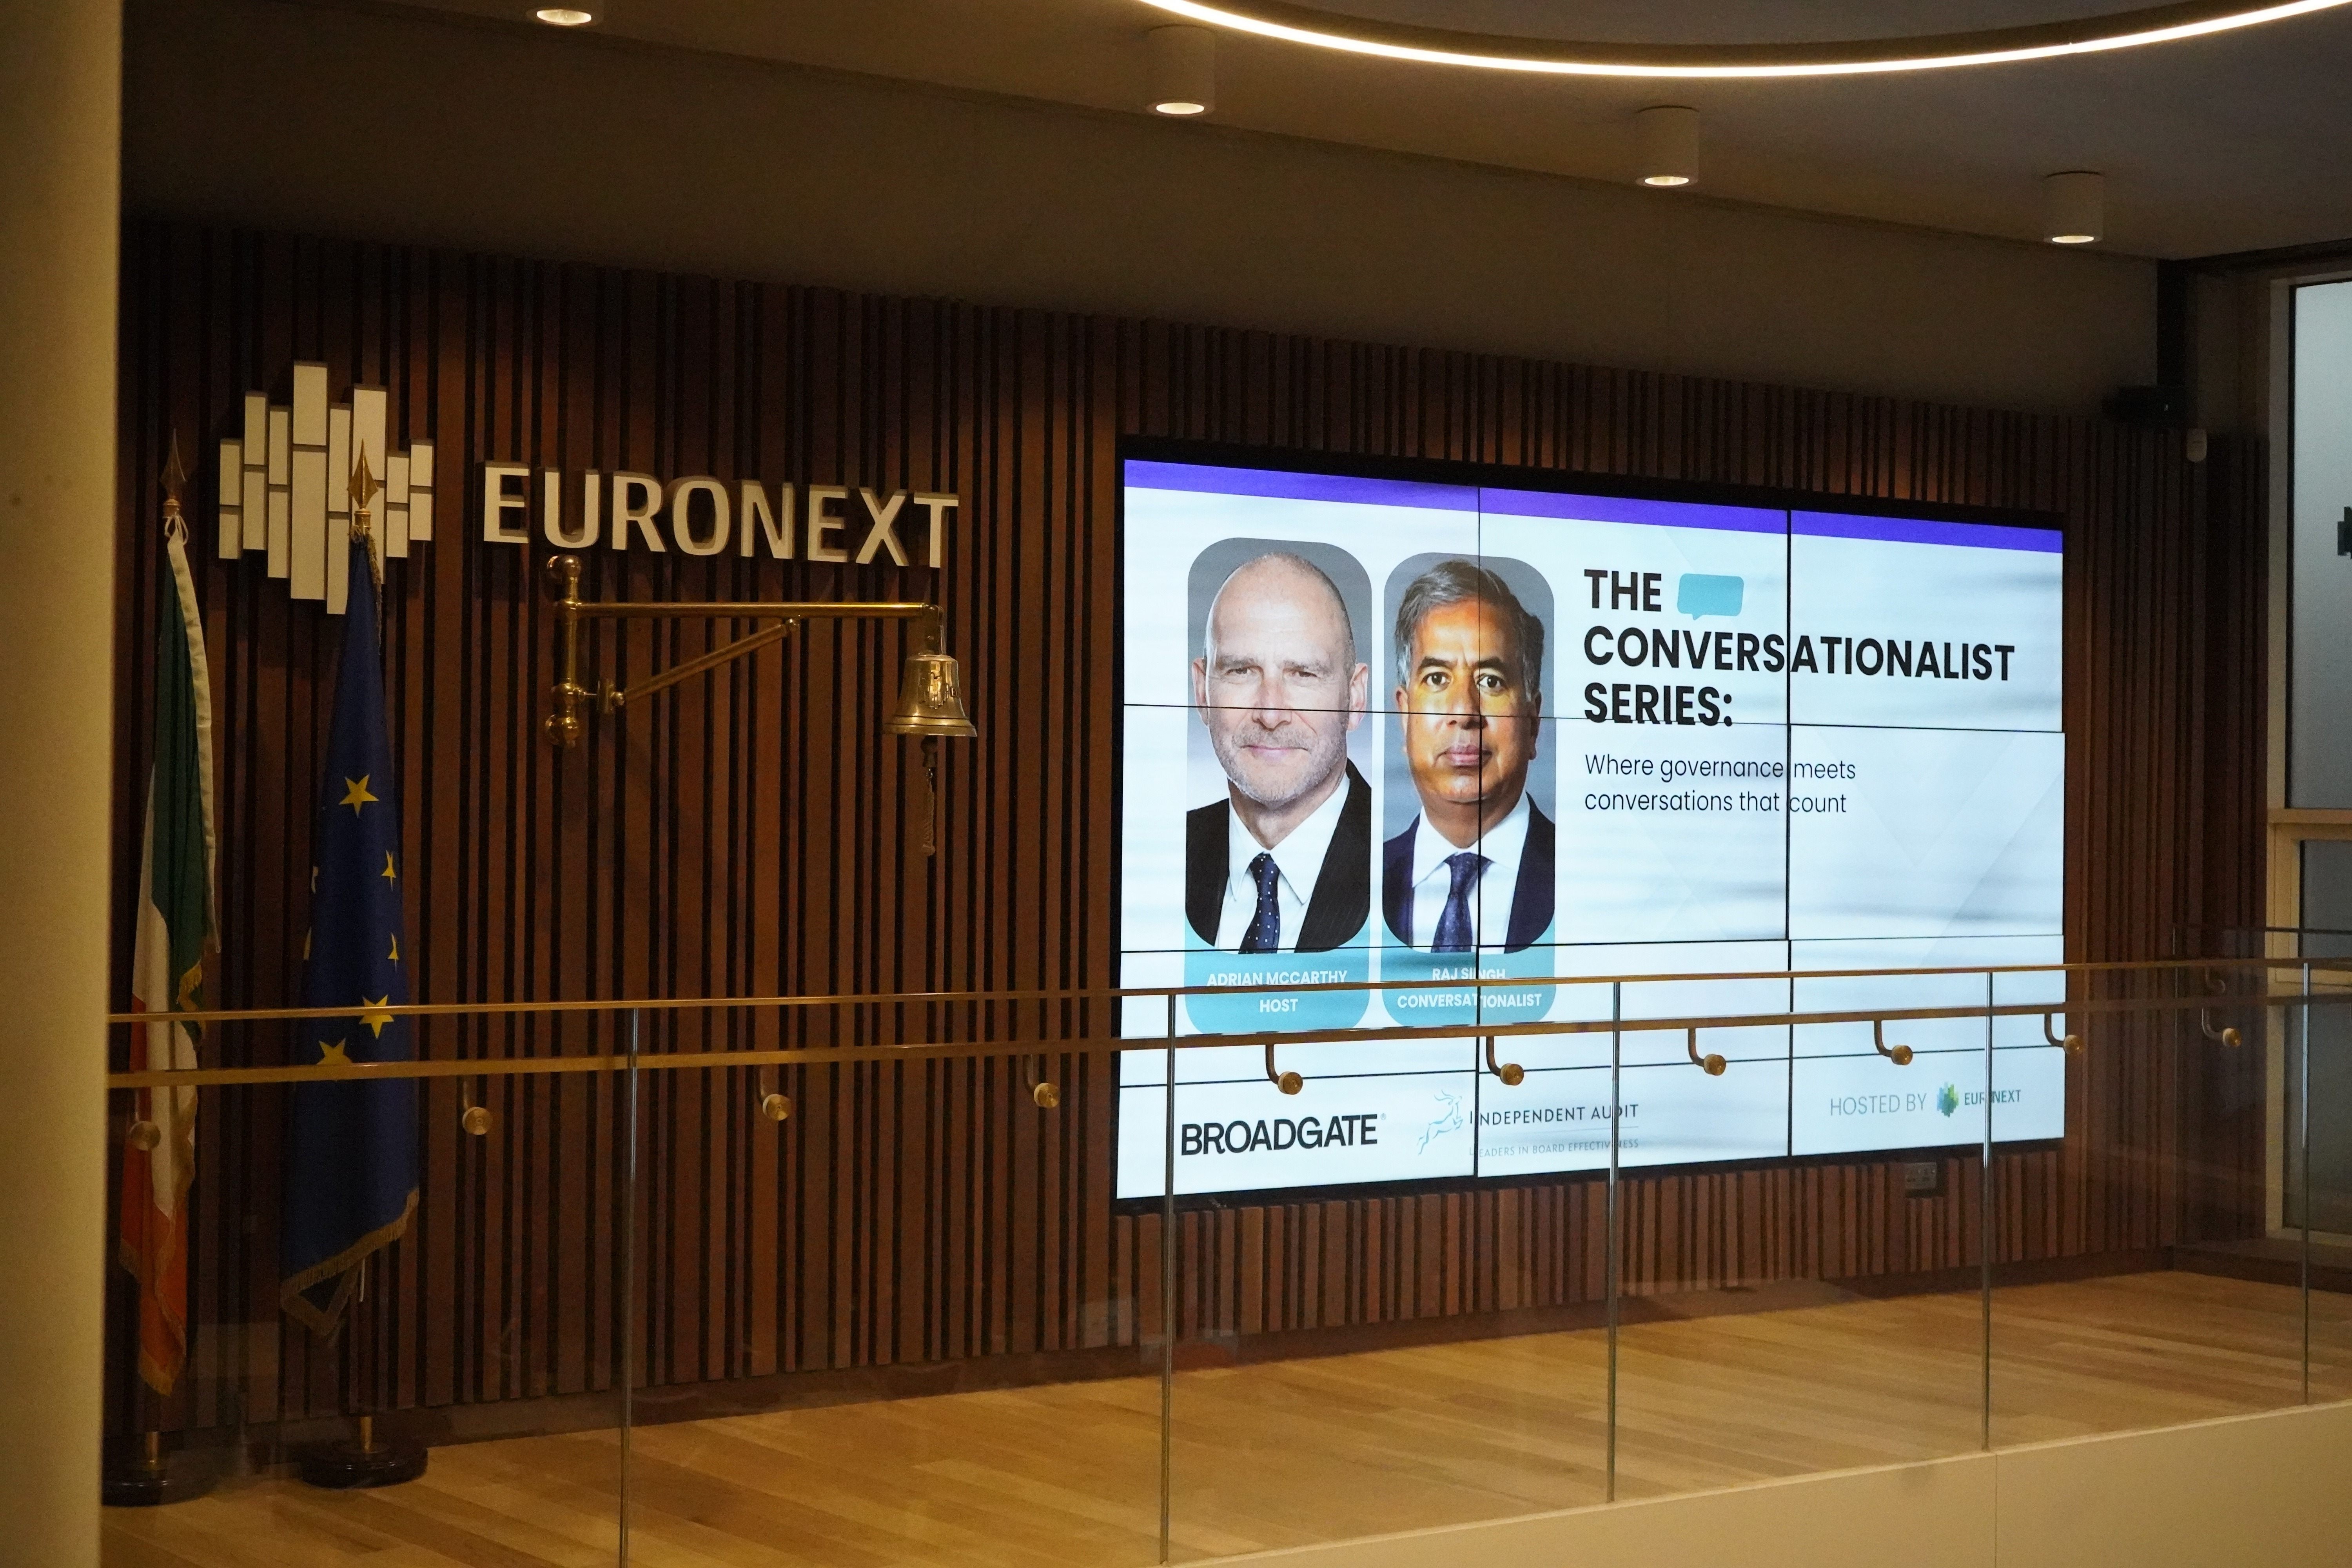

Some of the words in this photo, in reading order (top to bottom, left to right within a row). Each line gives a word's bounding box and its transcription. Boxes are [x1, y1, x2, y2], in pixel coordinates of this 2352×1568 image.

[483, 461, 960, 568] EURONEXT
[1584, 569, 1662, 612] THE
[1584, 626, 2015, 681] CONVERSATIONALIST
[1584, 682, 1733, 727] SERIES:
[1585, 754, 1653, 776] Where
[1661, 759, 1784, 782] governance
[1794, 760, 1856, 779] meets
[1585, 790, 1733, 811] conversations
[1739, 791, 1780, 811] that
[1789, 793, 1847, 813] count
[1207, 972, 1263, 986] ADRIAN
[1266, 970, 1348, 984] MCCARTHY
[1432, 968, 1458, 980] RAJ
[1461, 967, 1506, 980] SINGH
[1259, 998, 1299, 1013] HOST
[1397, 993, 1542, 1008] CONVERSATIONALIST
[1830, 1095, 1900, 1116] HOSTED
[1906, 1093, 1927, 1112] BY
[1964, 1089, 2021, 1105] EURNEXT
[1470, 1107, 1585, 1126] INDEPENDENT
[1181, 1114, 1377, 1156] BROADGATE
[1469, 1146, 1515, 1157] LEADERS
[1519, 1146, 1528, 1154] IN
[1533, 1144, 1564, 1154] BOARD
[1568, 1139, 1639, 1152] EFFECTIVESS
